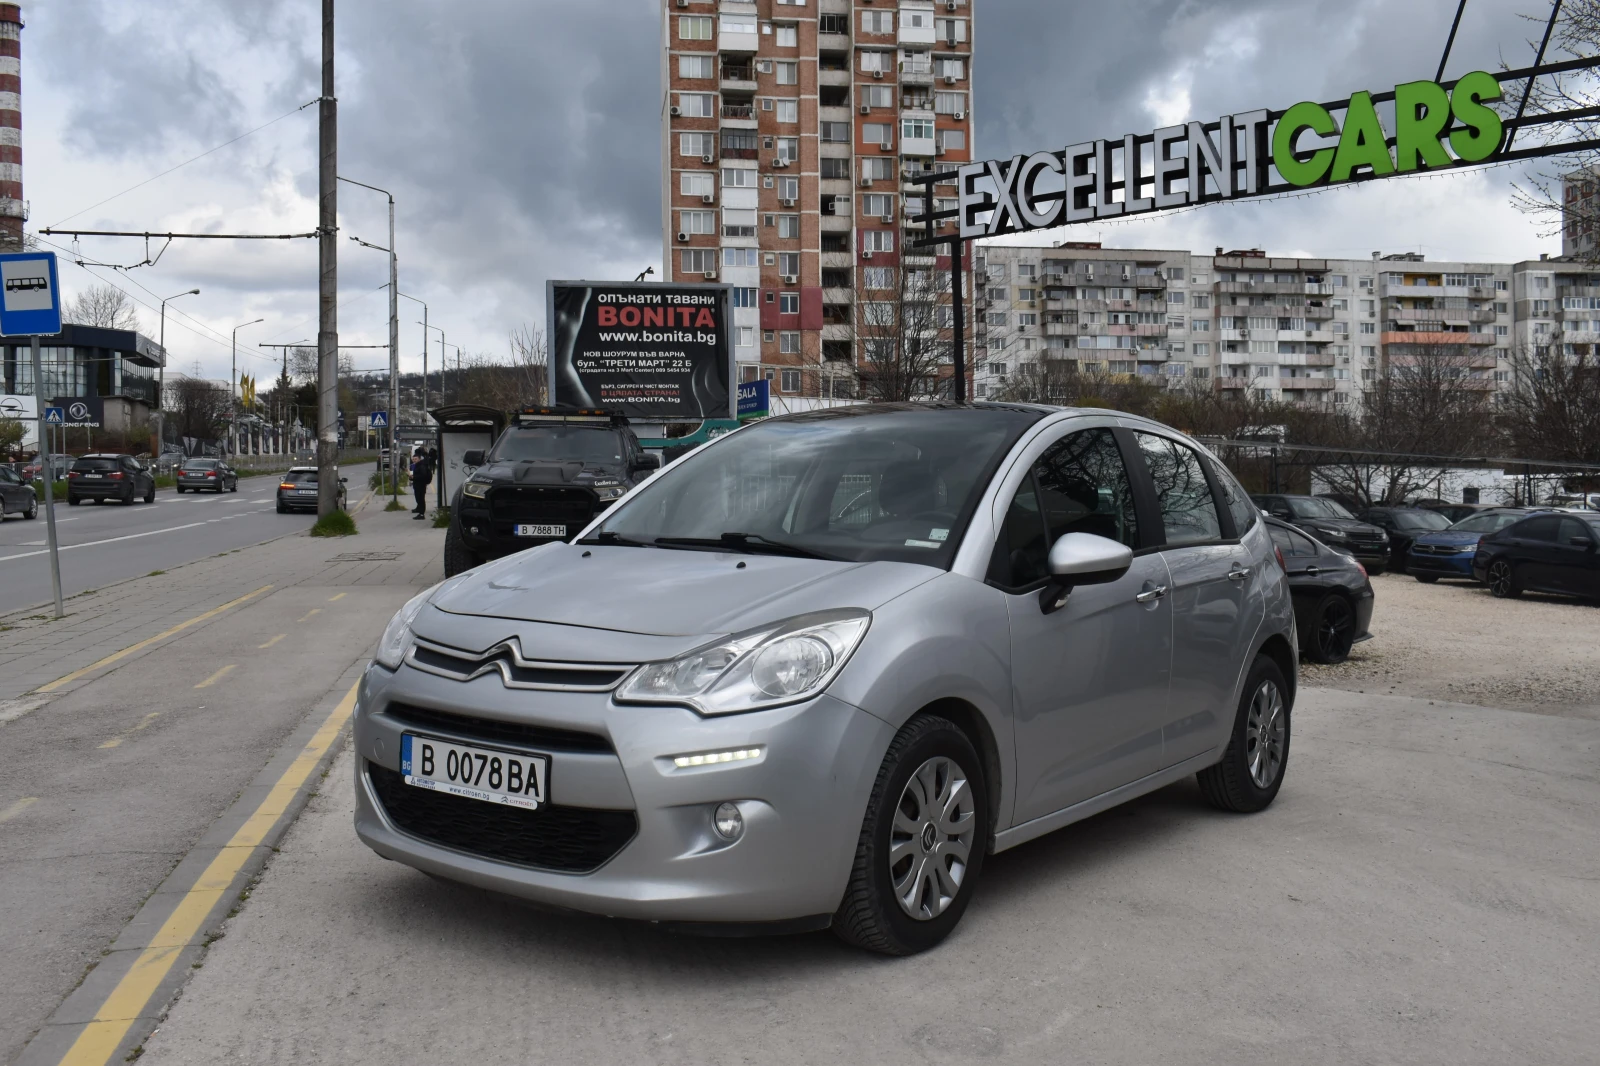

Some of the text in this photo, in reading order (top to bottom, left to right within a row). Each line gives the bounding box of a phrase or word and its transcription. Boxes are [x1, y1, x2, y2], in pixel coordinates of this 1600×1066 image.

[597, 293, 715, 305] опънати тавани
[598, 306, 715, 327] BONITA
[598, 330, 716, 346] www.bonita.bg
[583, 350, 601, 358] НОВ
[602, 350, 638, 358] ШОУРУМ
[577, 359, 598, 368] бул.
[672, 359, 683, 367] 22
[685, 359, 692, 367] Б
[601, 396, 681, 404] www.BONITA.bg
[521, 525, 528, 535] B
[553, 526, 565, 535] TH
[402, 761, 412, 771] BG
[421, 744, 540, 797] B 0078 BA
